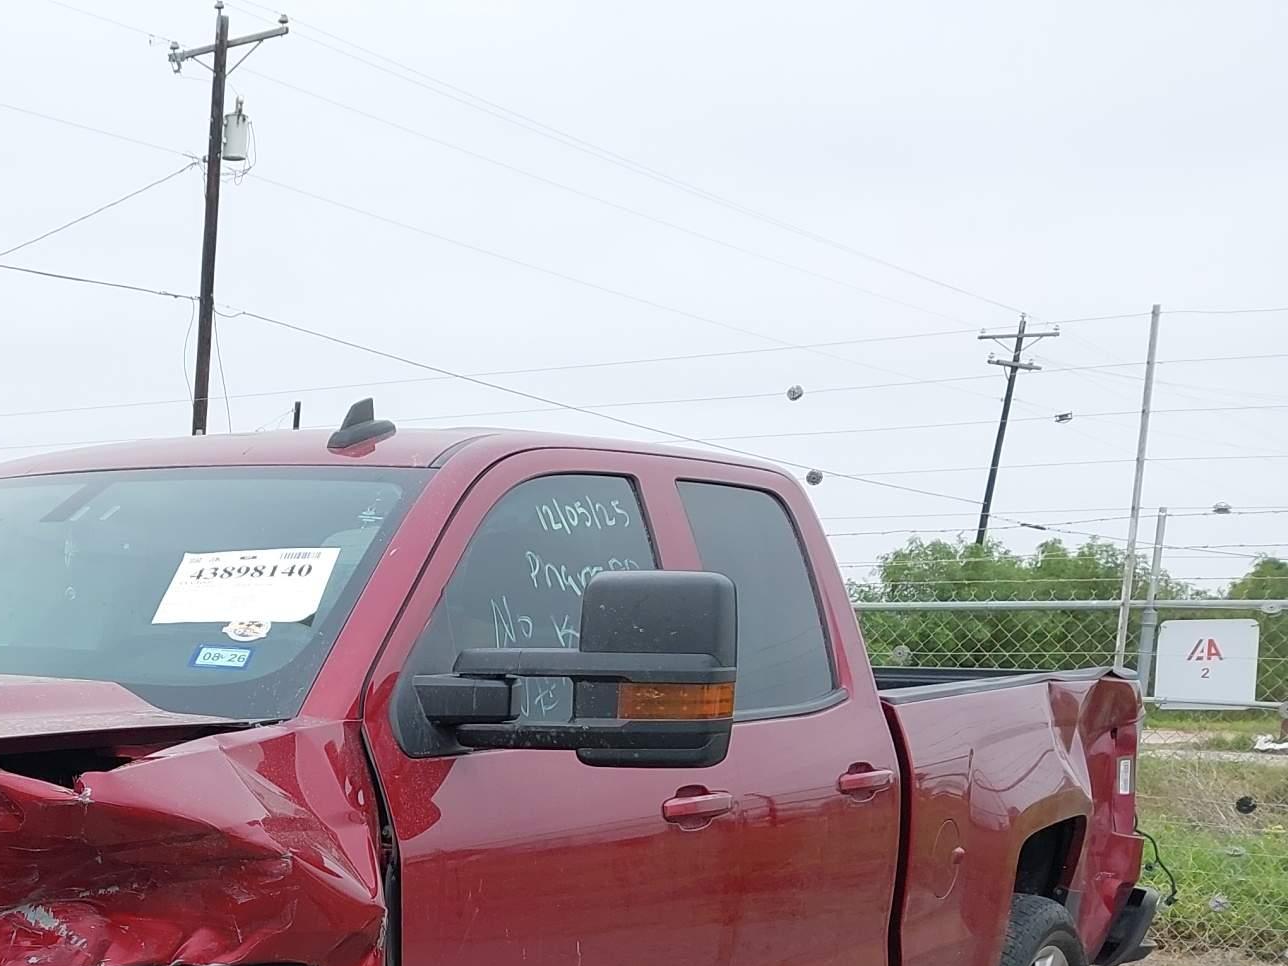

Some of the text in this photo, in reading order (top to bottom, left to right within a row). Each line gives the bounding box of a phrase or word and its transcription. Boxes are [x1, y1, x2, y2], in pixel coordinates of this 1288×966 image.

[535, 495, 630, 534] 12/05/25
[190, 564, 313, 580] 43898140
[1200, 667, 1210, 679] 2
